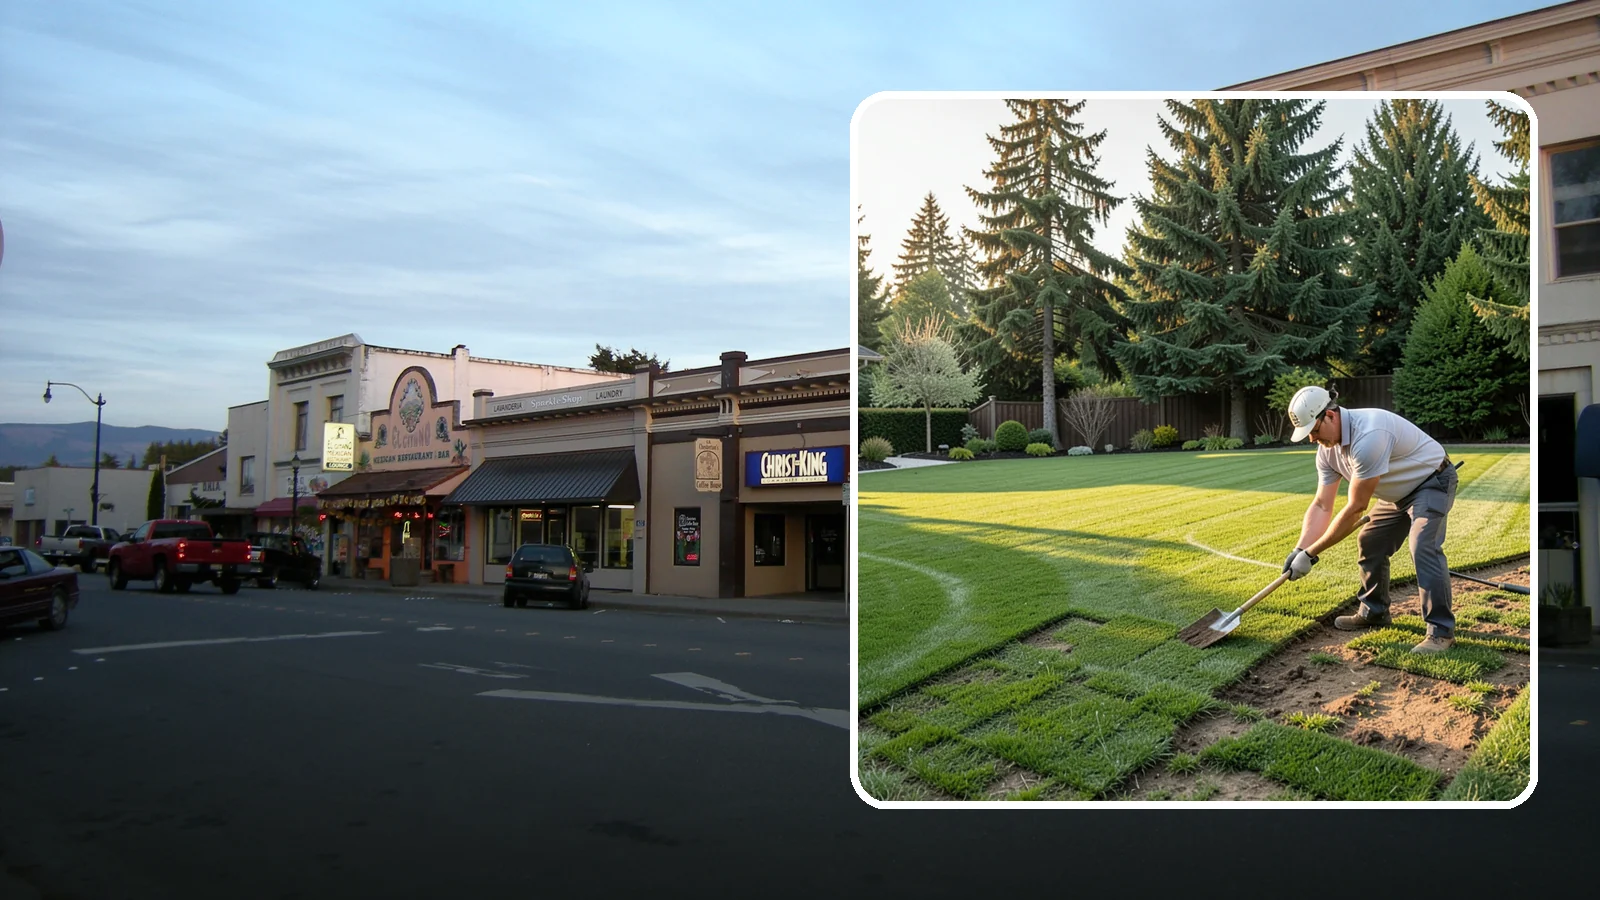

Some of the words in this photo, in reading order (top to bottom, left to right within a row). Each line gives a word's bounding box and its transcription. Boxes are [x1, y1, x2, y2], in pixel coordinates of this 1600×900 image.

[595, 389, 623, 400] LAUNDRY
[493, 402, 523, 413] LAVANDERIA
[531, 398, 561, 408] Sparkle
[562, 395, 582, 405] Shop
[373, 455, 396, 464] MEXICAN
[397, 451, 433, 462] RESTAURANT
[438, 450, 450, 459] BAR
[761, 452, 797, 478] CHRIST
[799, 450, 827, 476] KING
